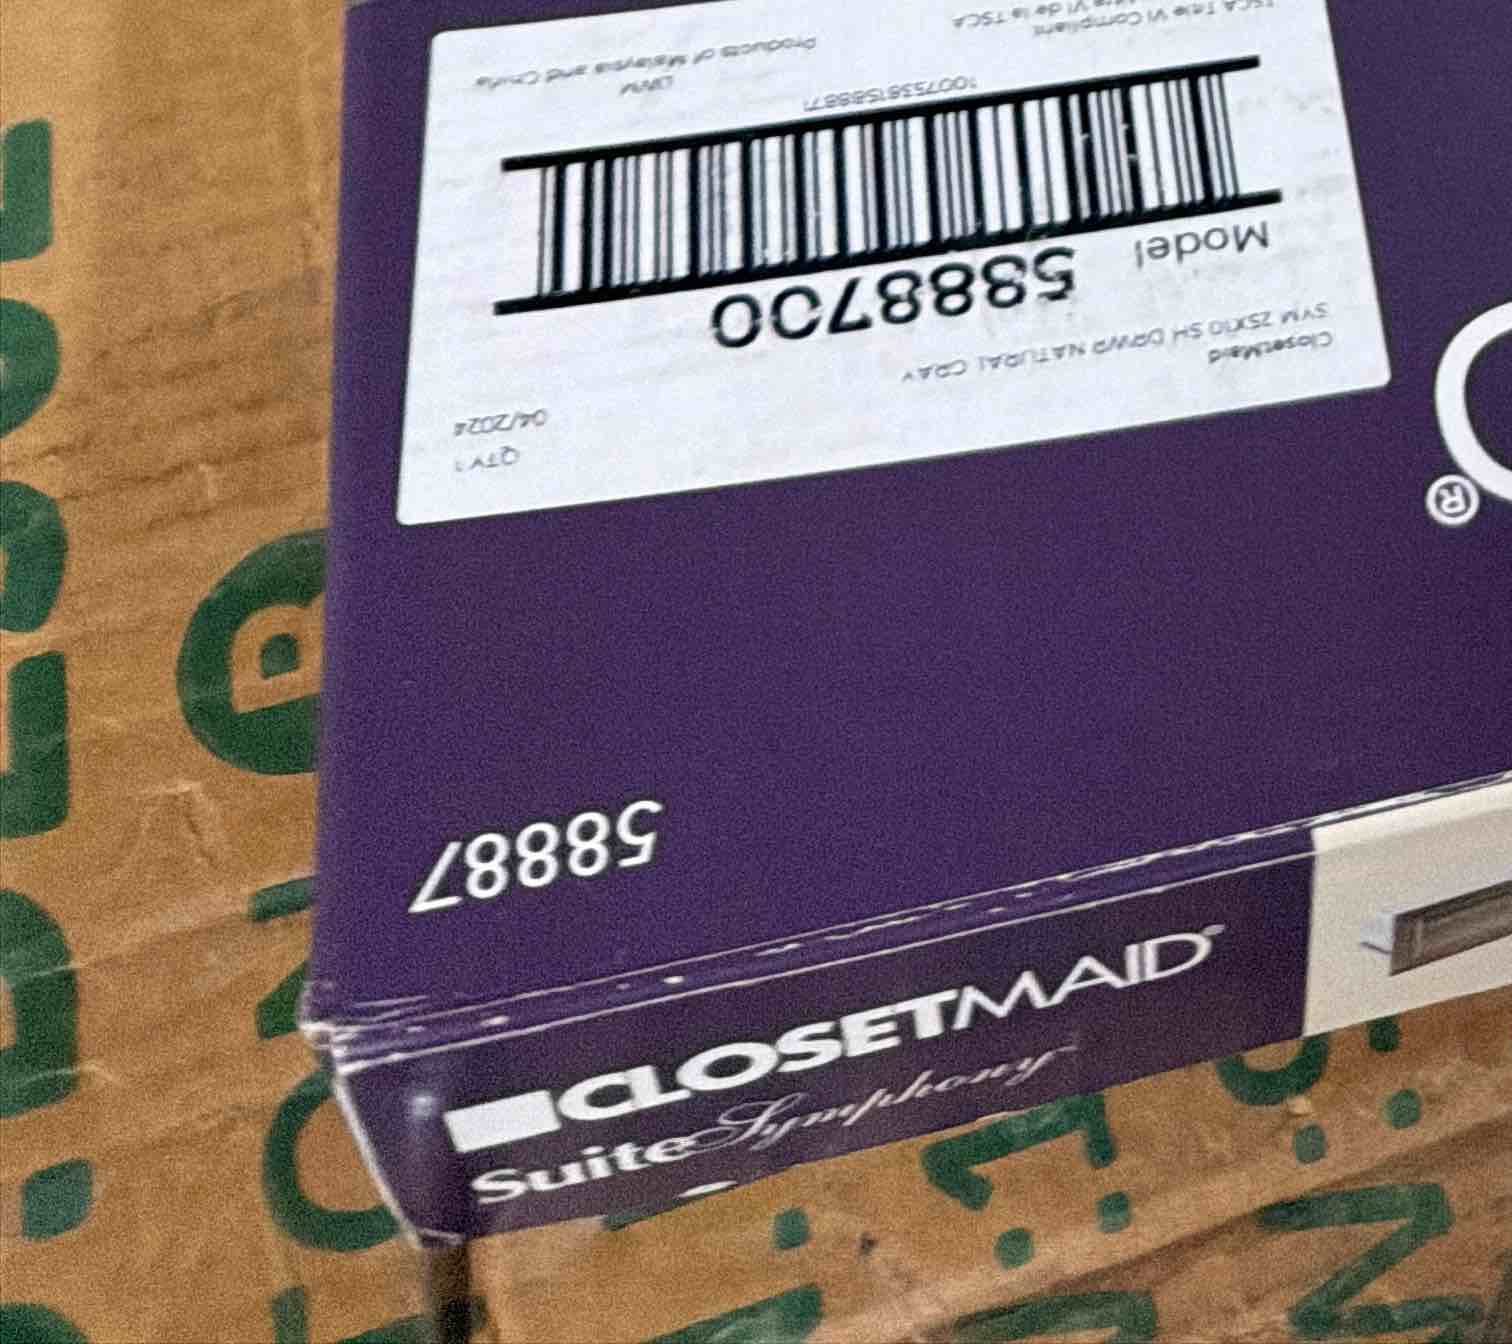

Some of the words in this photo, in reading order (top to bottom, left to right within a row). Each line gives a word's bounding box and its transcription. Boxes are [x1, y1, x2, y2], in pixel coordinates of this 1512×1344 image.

[951, 10, 1006, 31] TSCA
[1032, 7, 1143, 39] Compliant
[595, 50, 687, 78] Malaysia
[722, 34, 819, 64] Products
[471, 69, 539, 95] China
[546, 64, 588, 84] and
[1130, 220, 1271, 272] Model
[708, 242, 1080, 352] 5888700
[977, 340, 1087, 372] NATURAL
[1206, 329, 1335, 366] ClosetMaid
[405, 797, 665, 916] 58887
[555, 923, 1219, 1127] CLOSETMAID
[468, 1126, 690, 1206] Suite
[672, 1040, 1081, 1160] Symphony
